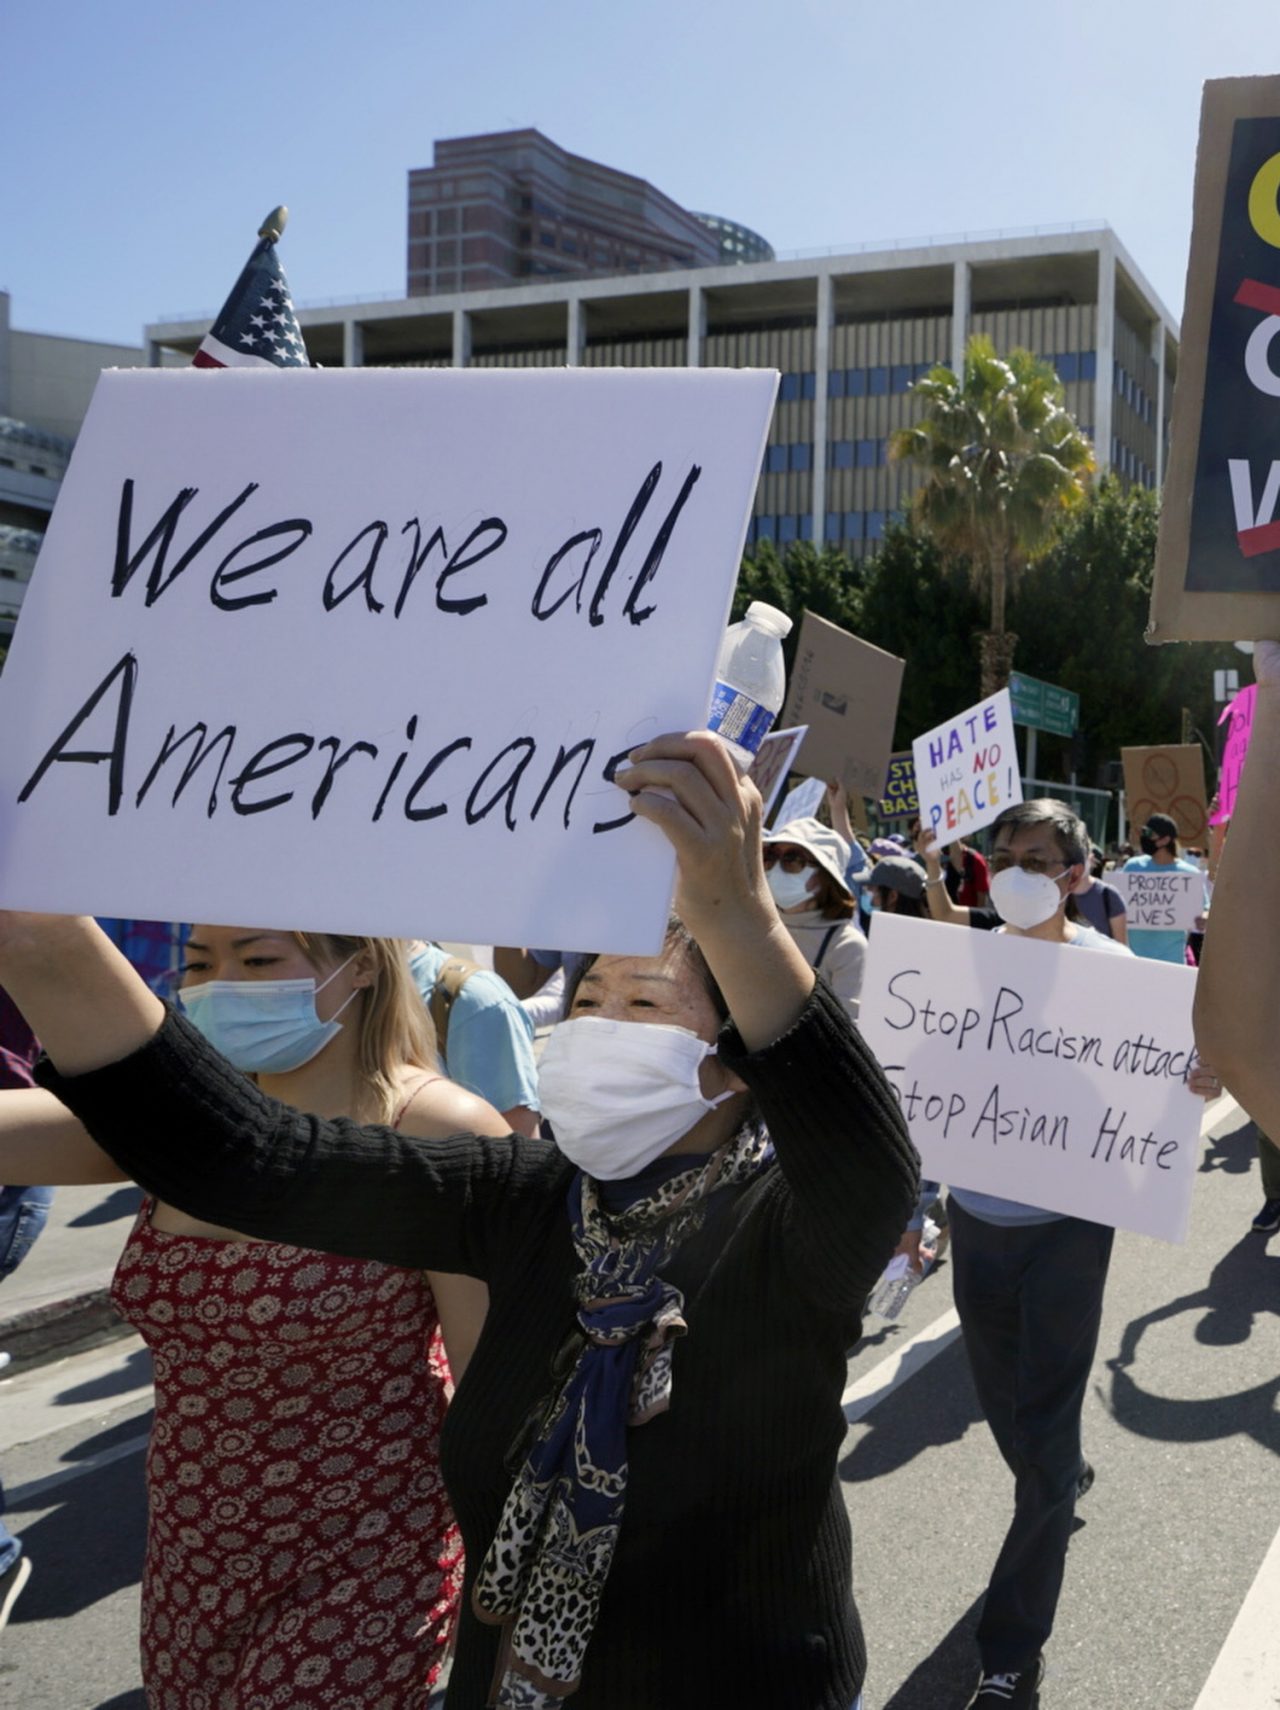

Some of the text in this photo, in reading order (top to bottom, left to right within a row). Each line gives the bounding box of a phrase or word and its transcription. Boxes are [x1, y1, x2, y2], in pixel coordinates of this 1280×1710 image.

[110, 459, 702, 626] We are all
[928, 705, 998, 769] HATE
[890, 760, 913, 779] ST
[939, 743, 1002, 792] HAS NO
[886, 778, 914, 796] CH
[881, 795, 920, 816] BAS
[1128, 873, 1192, 893] PROTECT
[1128, 891, 1176, 906] ASIAN
[1126, 908, 1177, 926] LIVES
[884, 969, 980, 1051] Stop
[987, 986, 1104, 1068] Racism
[971, 1083, 1070, 1151] Asian
[1090, 1107, 1179, 1170] Hate
